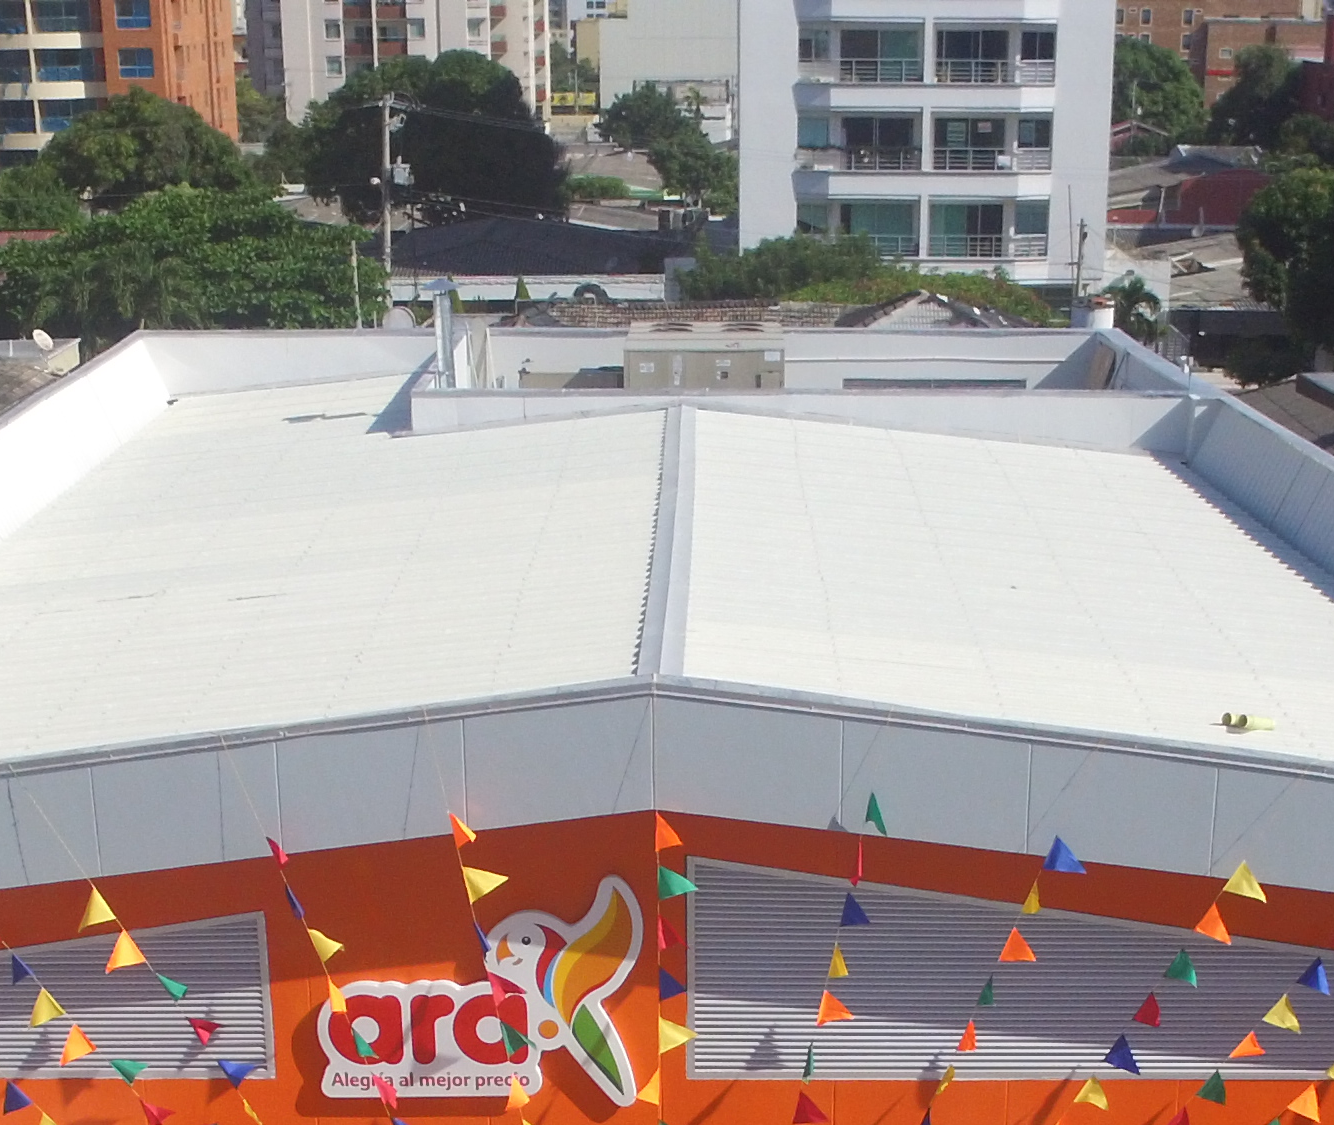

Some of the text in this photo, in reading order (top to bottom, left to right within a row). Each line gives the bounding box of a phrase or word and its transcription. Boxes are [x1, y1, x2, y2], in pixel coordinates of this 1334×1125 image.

[328, 994, 529, 1065] ara
[399, 1071, 414, 1087] al
[419, 1072, 471, 1091] mejor
